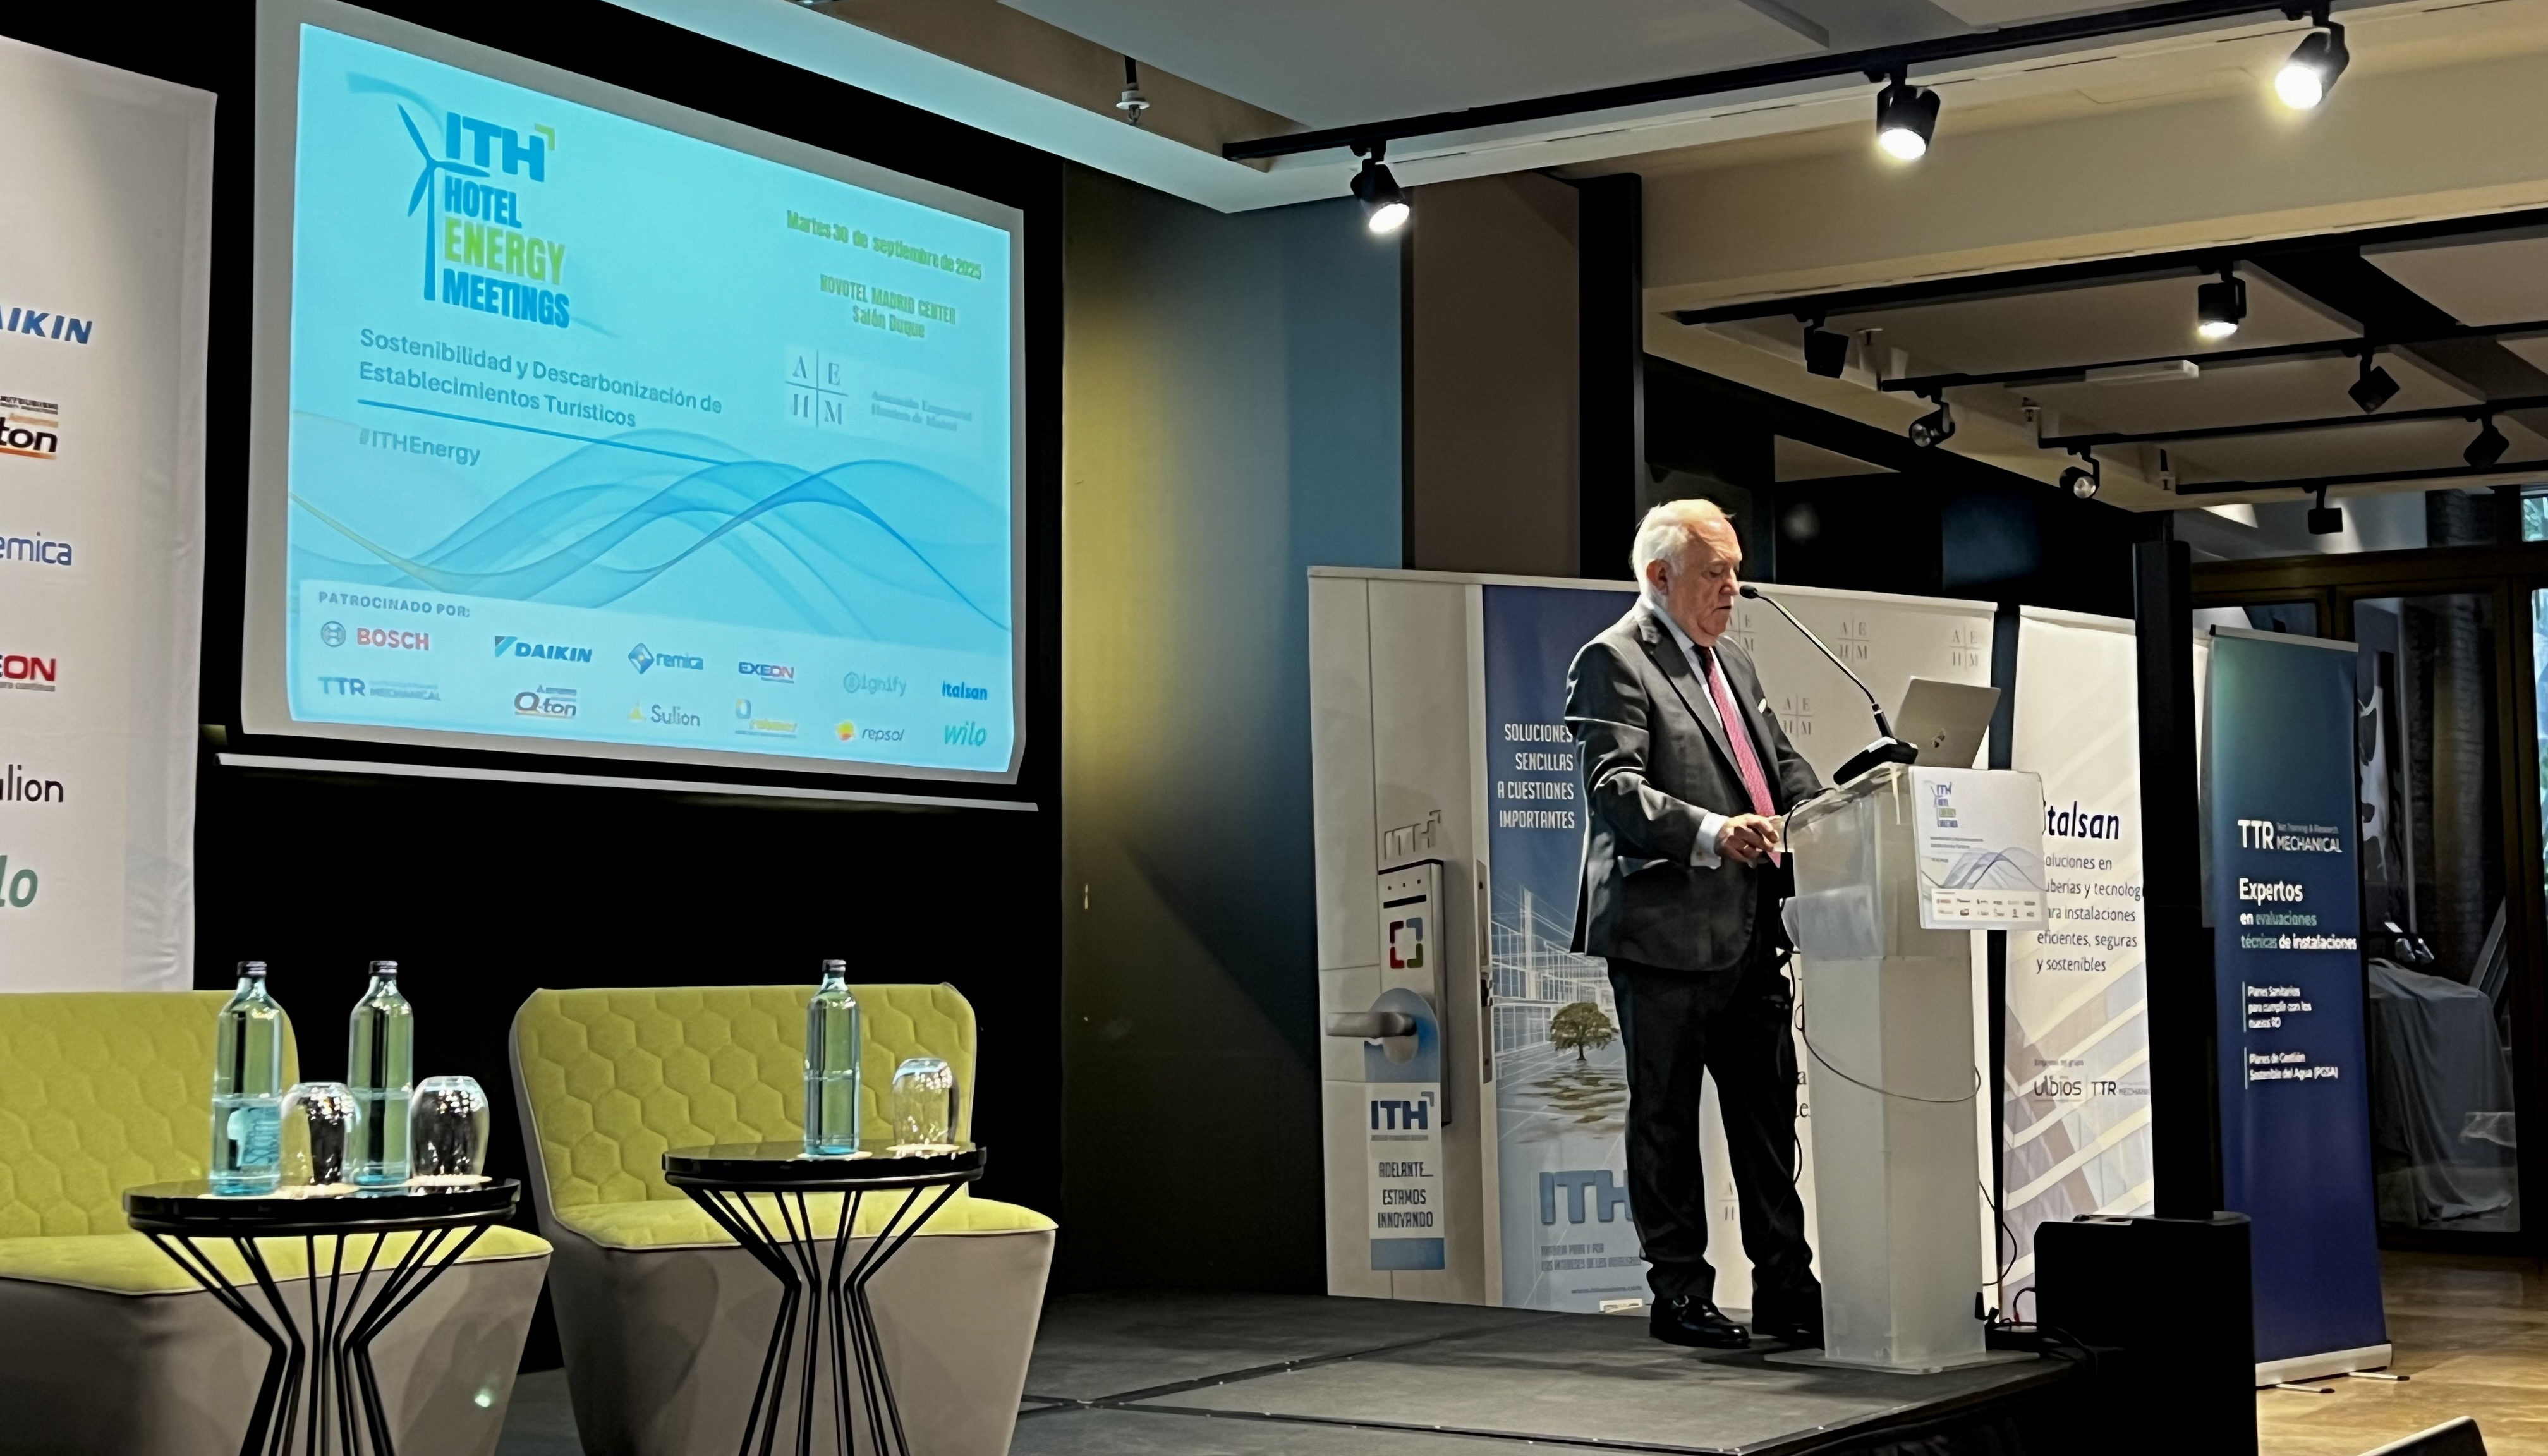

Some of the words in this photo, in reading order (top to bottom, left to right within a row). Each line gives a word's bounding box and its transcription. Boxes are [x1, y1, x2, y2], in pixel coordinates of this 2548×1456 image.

[446, 112, 544, 182] ITH
[445, 176, 522, 228] HOTEL
[444, 215, 565, 285] ENERGY
[443, 268, 569, 329] MEETINGS
[820, 274, 868, 303] NOVOTEL
[871, 287, 914, 314] MADRID
[918, 300, 956, 325] CENTER
[0, 307, 92, 344] IKIN
[360, 328, 511, 373] Sostenibilidad
[516, 361, 528, 380] y
[533, 361, 696, 409] Descarbonización
[700, 395, 722, 414] de
[360, 361, 540, 410] Establecimientos
[543, 394, 636, 427] Turísticos
[318, 592, 432, 614] PATROCINADO
[436, 604, 470, 617] POR:
[356, 628, 429, 650] BOSCH
[514, 642, 592, 663] DAIKIN
[0, 655, 56, 681] ON
[738, 662, 794, 679] EXEON
[318, 677, 366, 696] TTR
[651, 704, 701, 727] Sulion
[862, 729, 904, 743] repsol
[945, 720, 987, 746] wilo
[1505, 724, 1573, 743] SOLUCIONES
[1515, 752, 1574, 772] SENCILLAS
[1498, 780, 1505, 799] A
[1508, 781, 1574, 800] CUESTIONES
[1500, 810, 1575, 829] IMPORTANTES
[2045, 801, 2120, 840] talsan
[2238, 819, 2274, 850] TTR
[2276, 835, 2343, 852] MECHANICAL
[2045, 852, 2095, 870] oluciones
[2099, 859, 2112, 870] en
[2084, 884, 2090, 899] y
[2094, 882, 2141, 901] tecnolog
[2239, 878, 2303, 906] Expertos
[2065, 904, 2135, 922] instalaciones
[2240, 913, 2254, 925] en
[2256, 910, 2317, 926] evaluaciones
[2037, 930, 2091, 947] eficientes,
[2095, 935, 2138, 950] seguras
[2279, 933, 2291, 949] de
[2293, 933, 2357, 950] instalaciones
[2037, 959, 2044, 974] y
[2046, 957, 2106, 971] sostenibles
[2091, 1081, 2117, 1096] TTR
[1371, 1100, 1428, 1130] ITH
[1383, 1189, 1426, 1205] ESTAMOS
[1539, 1170, 1634, 1225] ITH
[1378, 1211, 1433, 1228] INNOVANDO
